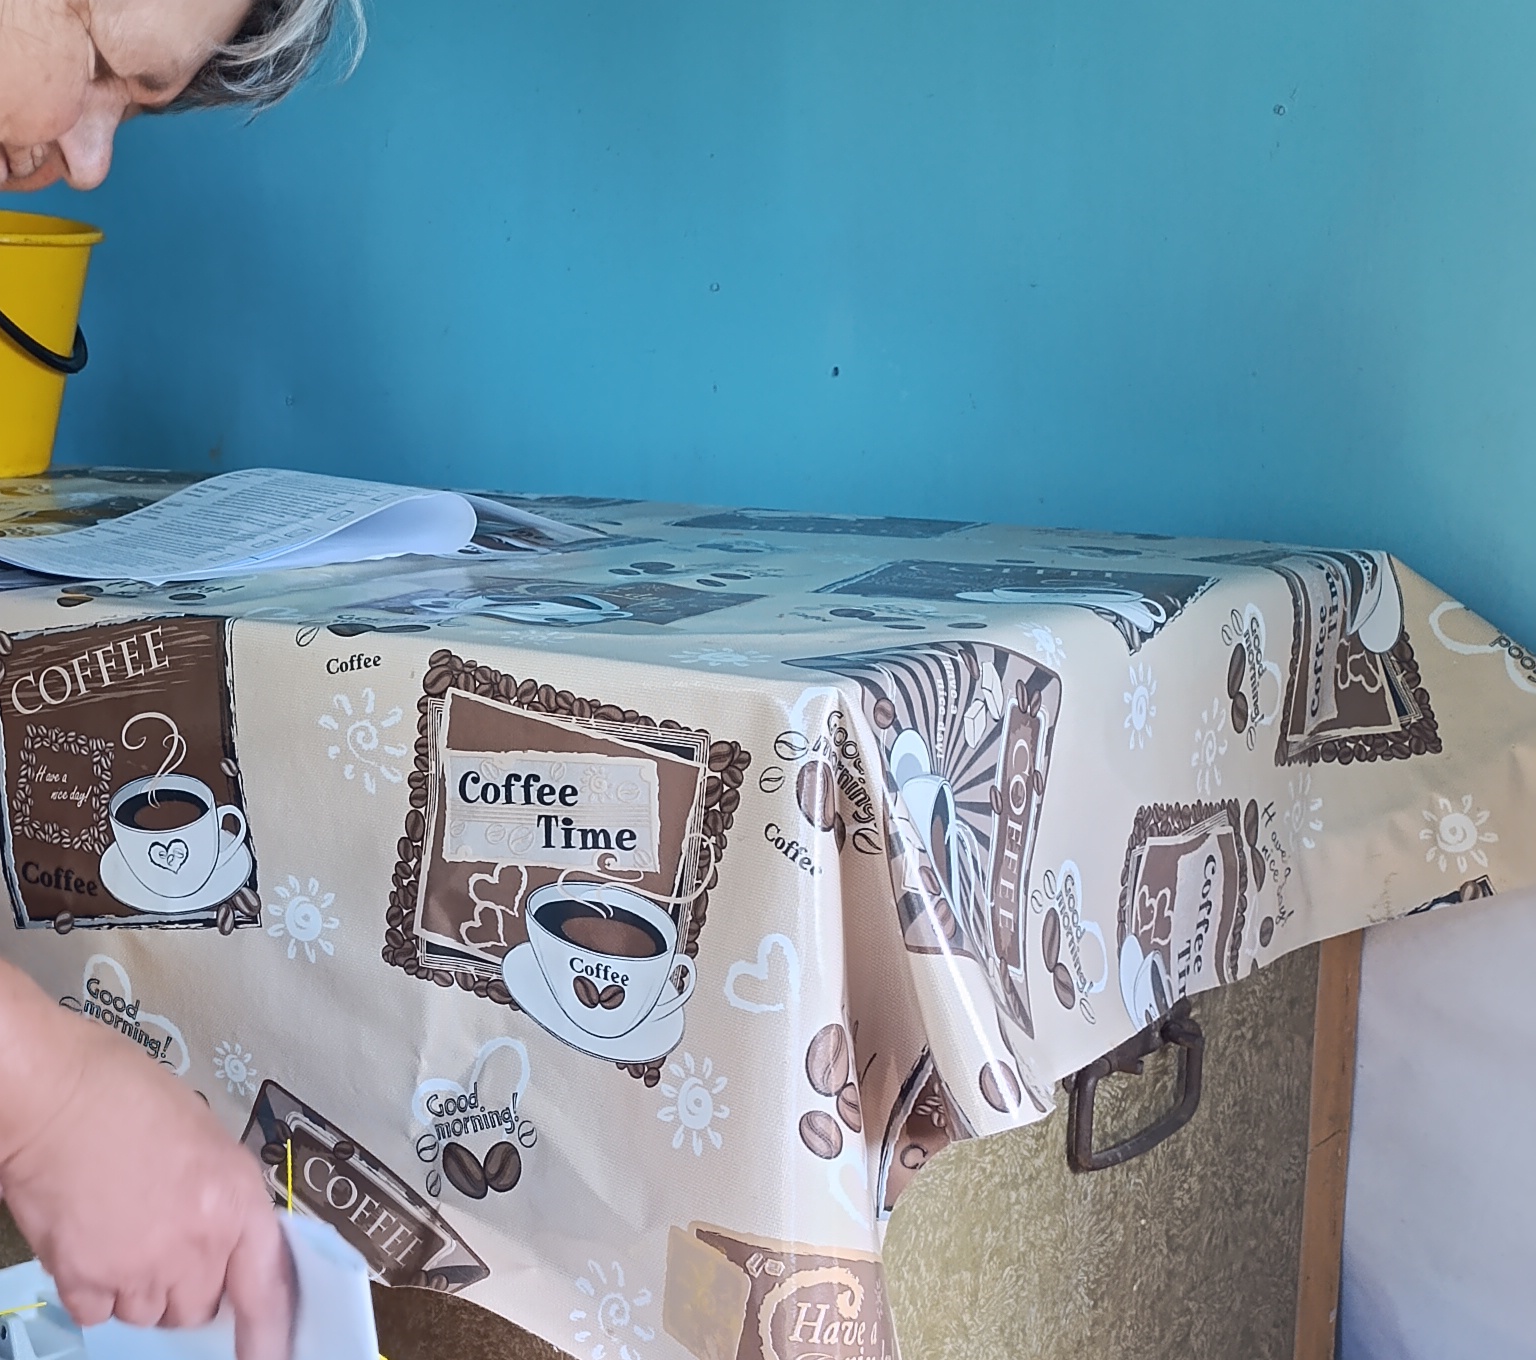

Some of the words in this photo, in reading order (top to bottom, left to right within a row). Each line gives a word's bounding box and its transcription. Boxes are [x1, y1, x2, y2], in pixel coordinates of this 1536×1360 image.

[11, 625, 170, 715] COFFEE
[325, 652, 382, 675] Coffee
[1250, 616, 1267, 680] Good
[1310, 605, 1327, 718] Coffee
[1489, 635, 1536, 683] ood
[1243, 628, 1264, 727] morning!
[35, 764, 59, 783] Have
[50, 788, 68, 800] nice
[69, 785, 92, 808] day!
[458, 769, 579, 808] Coffee
[812, 735, 878, 829] morning
[536, 815, 637, 853] Time
[995, 739, 1030, 931] COFFEE
[21, 861, 98, 896] Coffee
[1064, 874, 1086, 944] Good
[1193, 854, 1217, 976] Coffee
[1056, 890, 1094, 998] morning!
[1177, 938, 1191, 997] Ti
[86, 978, 140, 1020] Good
[568, 956, 630, 988] Coffee
[84, 1000, 173, 1059] morning!
[426, 1081, 479, 1118] Good
[434, 1092, 519, 1141] morning!
[304, 1156, 423, 1268] COFFEE
[788, 1302, 866, 1346] Have
[870, 1321, 878, 1345] a
